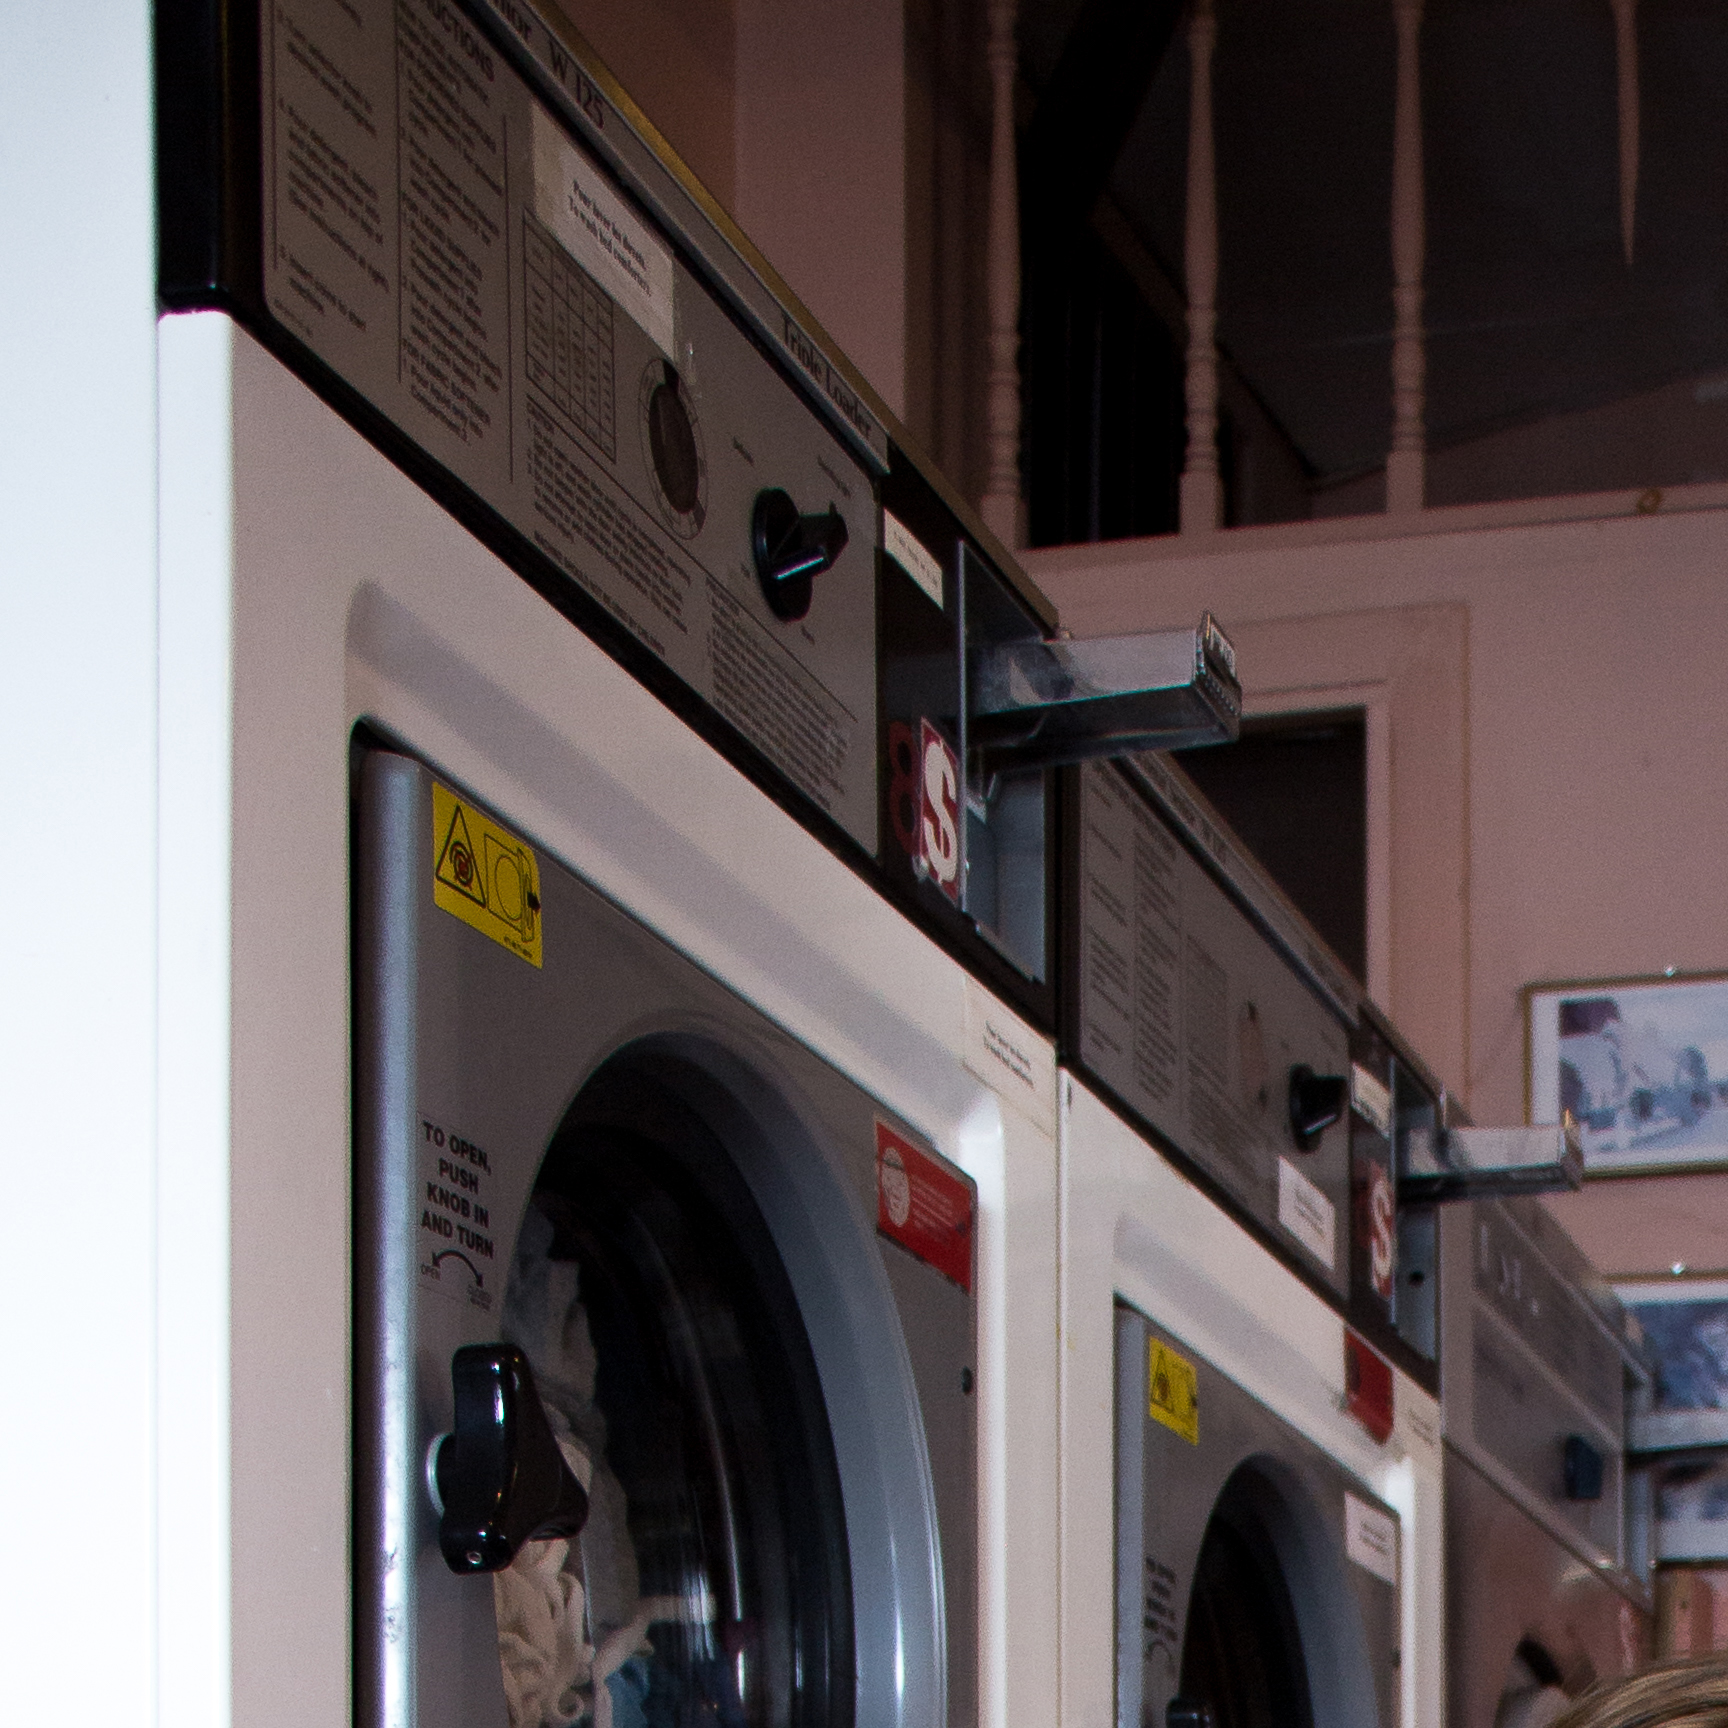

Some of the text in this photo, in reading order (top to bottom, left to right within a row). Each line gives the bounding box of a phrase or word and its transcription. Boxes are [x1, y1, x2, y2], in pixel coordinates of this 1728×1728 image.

[575, 71, 604, 129] 125
[782, 313, 822, 381] Triple
[826, 366, 872, 440] Loader
[423, 1120, 492, 1177] TO OPEN,
[438, 1157, 479, 1195] PUSH
[427, 1181, 489, 1229] KNOB IN
[421, 1209, 494, 1260] AND TURN
